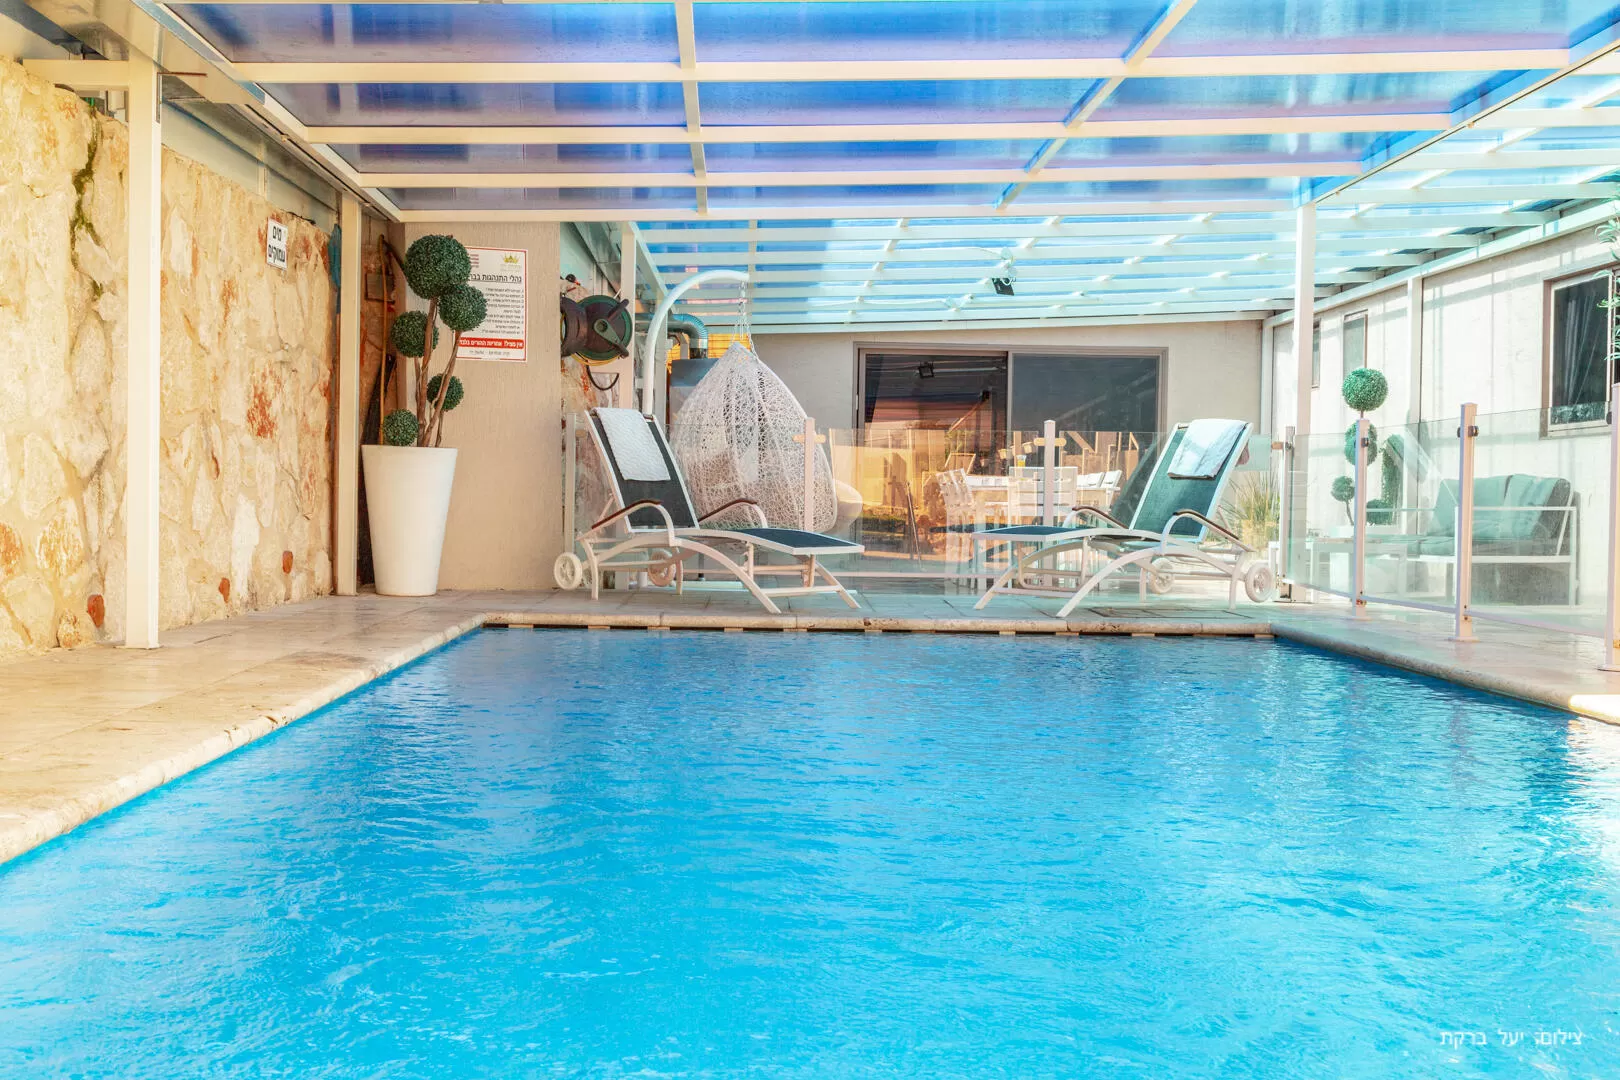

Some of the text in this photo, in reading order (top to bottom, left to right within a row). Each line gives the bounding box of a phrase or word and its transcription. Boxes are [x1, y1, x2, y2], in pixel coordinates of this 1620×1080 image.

[272, 226, 282, 241] מים
[268, 244, 286, 263] עמוקים
[509, 275, 522, 283] נהלי
